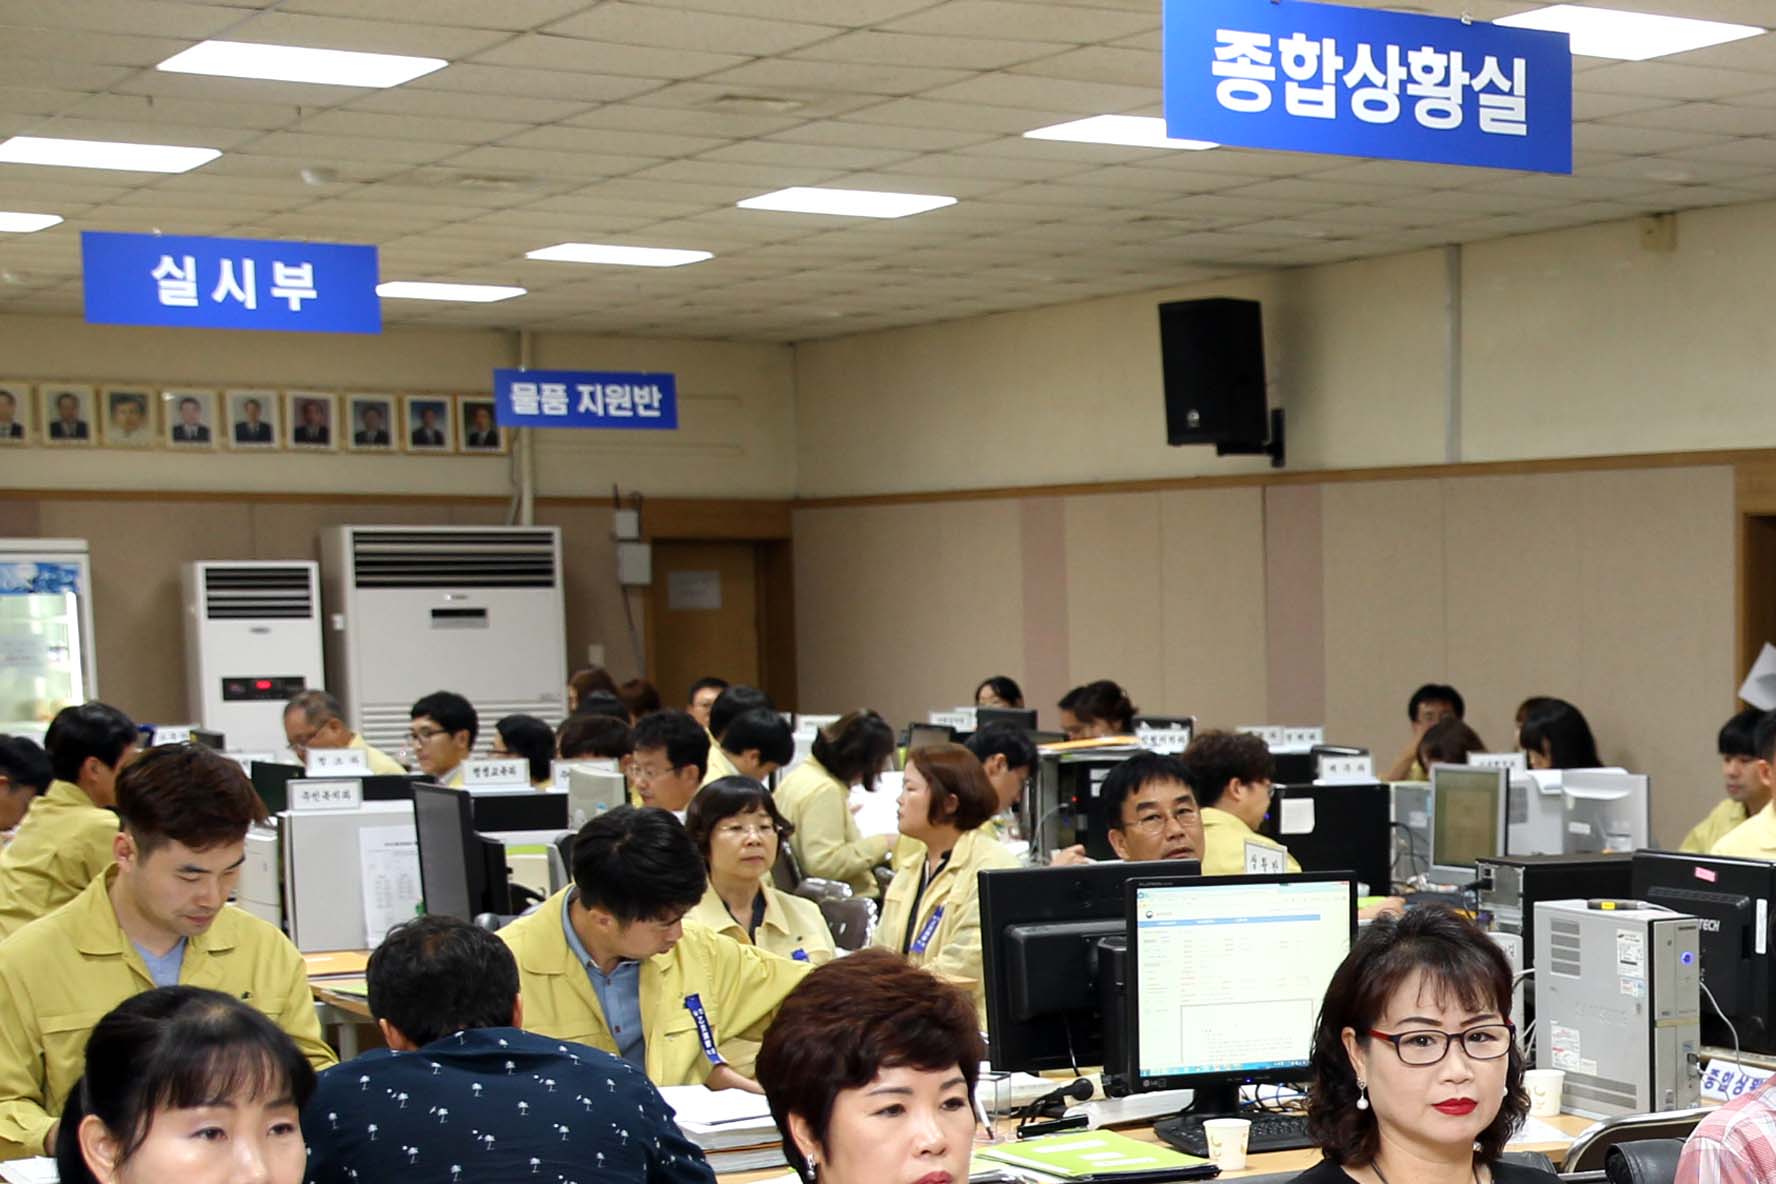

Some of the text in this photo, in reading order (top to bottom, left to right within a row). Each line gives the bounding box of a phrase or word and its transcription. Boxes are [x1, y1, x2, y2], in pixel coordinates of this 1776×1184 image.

[1211, 28, 1528, 136] 종합상황실
[151, 254, 318, 312] 실시부
[576, 384, 663, 417] 지원반
